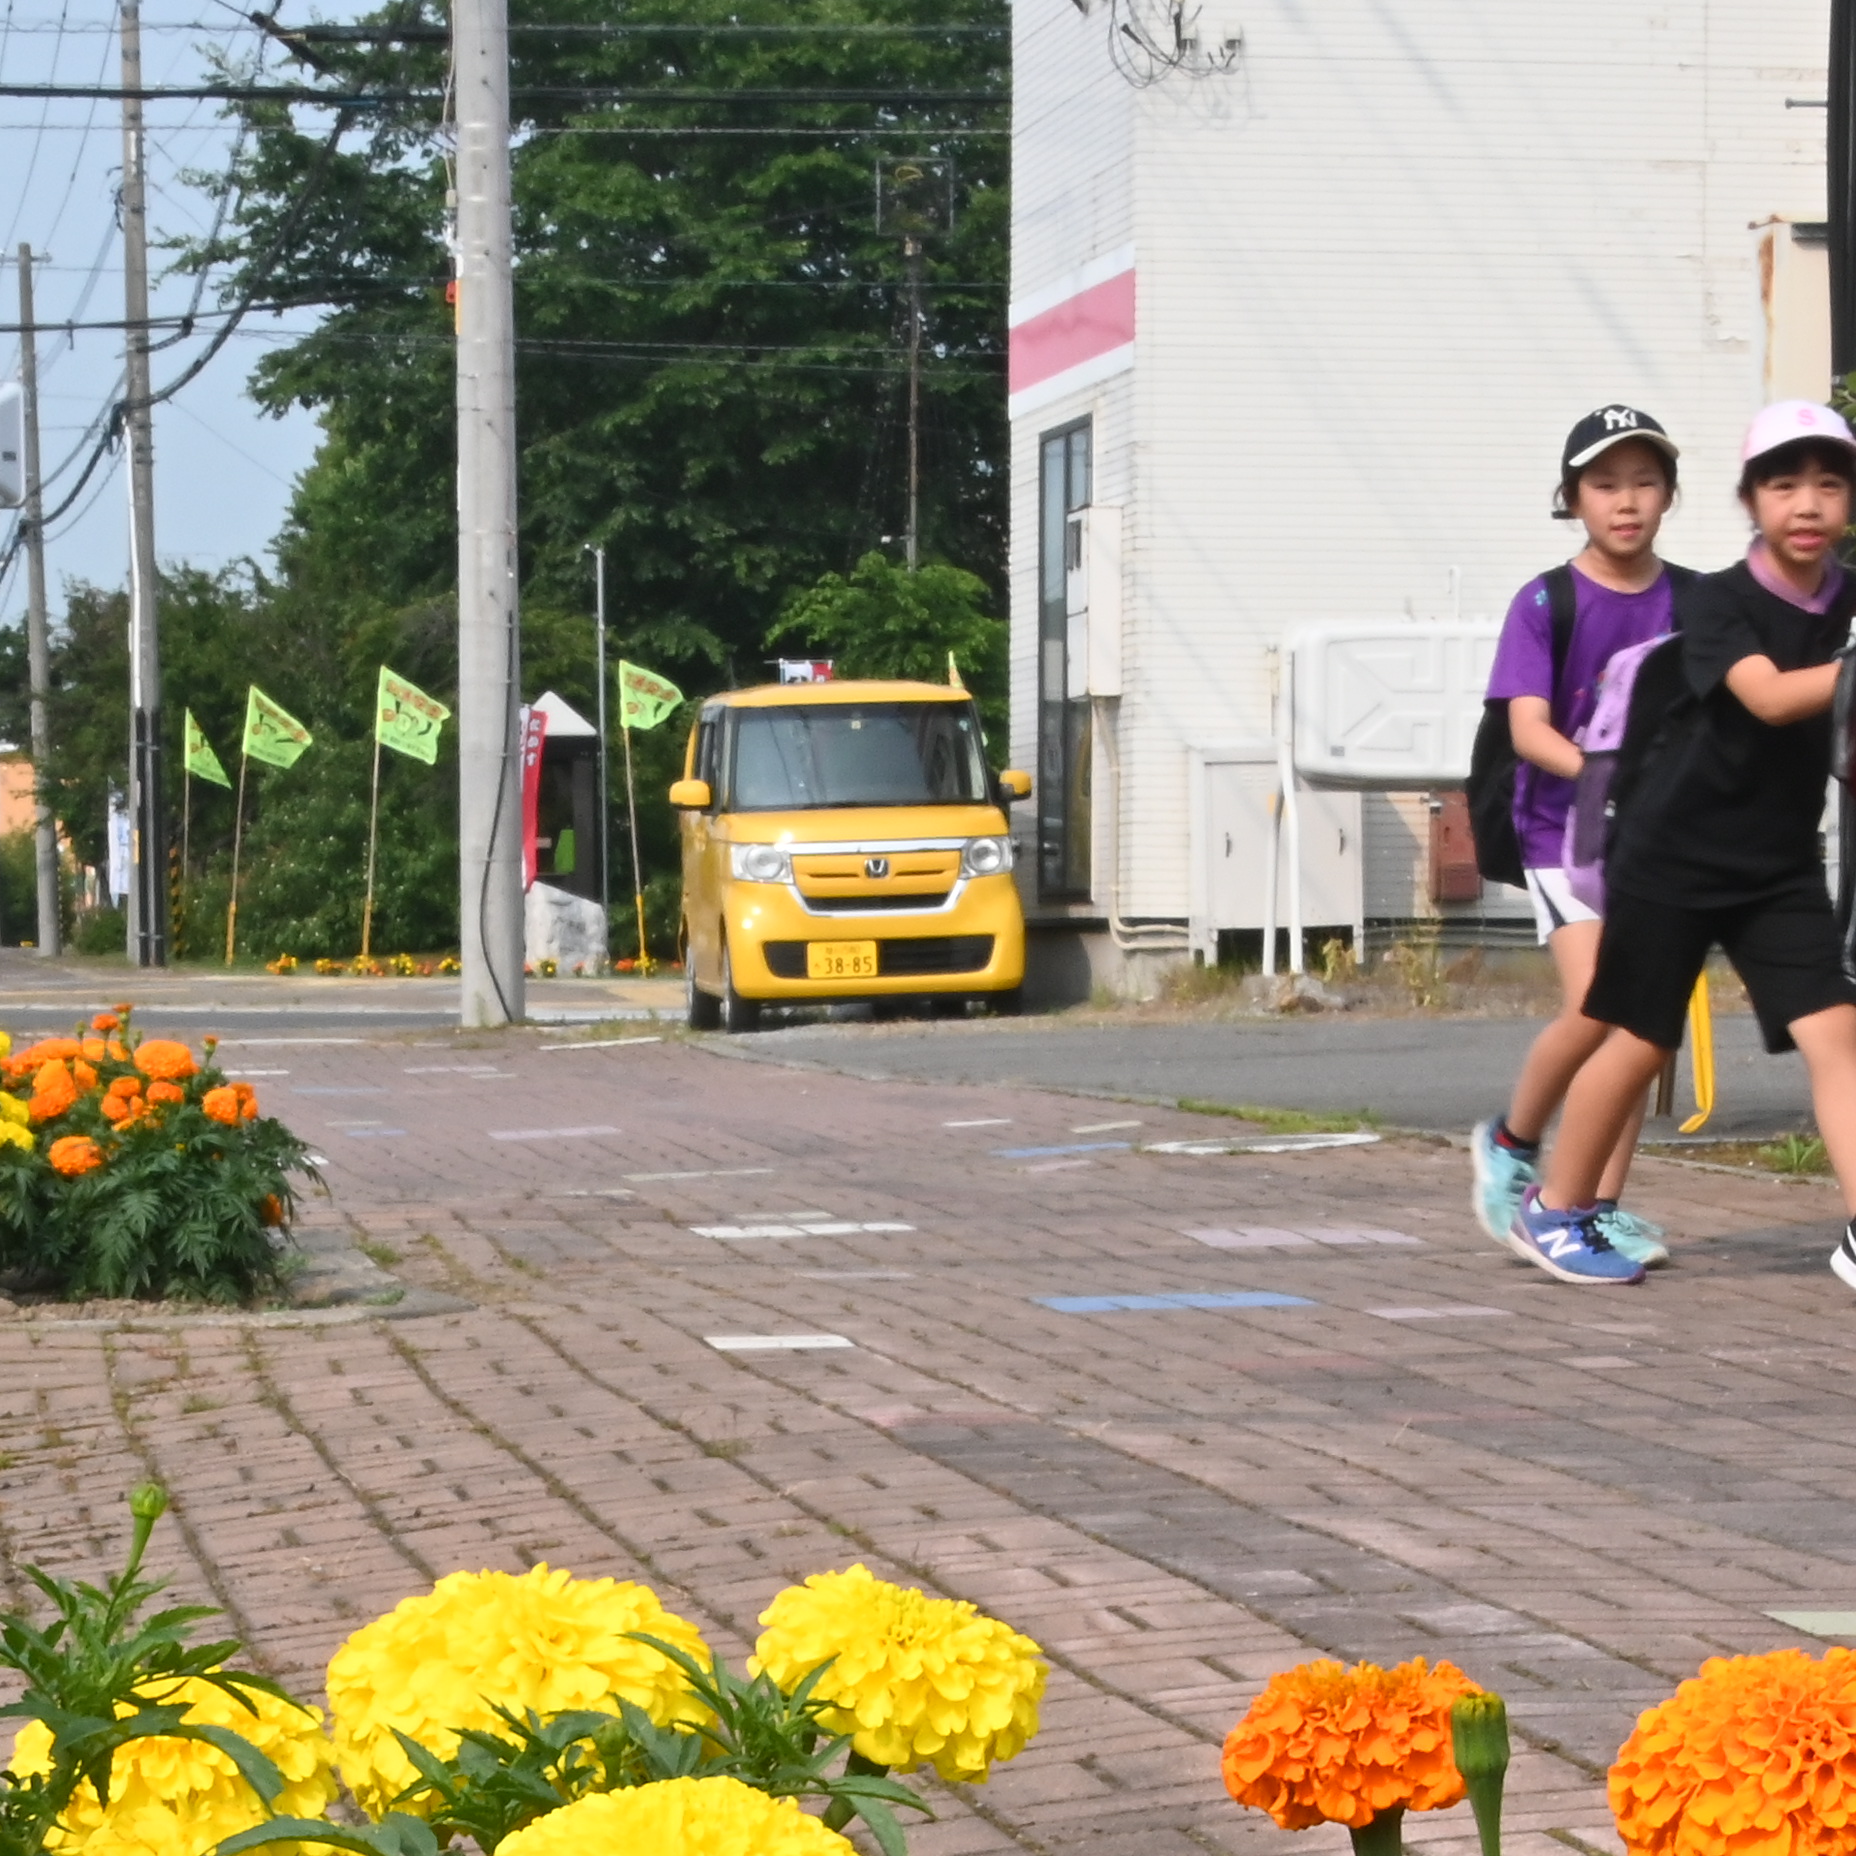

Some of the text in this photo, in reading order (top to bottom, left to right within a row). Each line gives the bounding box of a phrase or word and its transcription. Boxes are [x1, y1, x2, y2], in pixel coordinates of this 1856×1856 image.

[1797, 407, 1816, 426] S
[825, 956, 873, 974] 38-85
[1536, 1228, 1581, 1259] N
